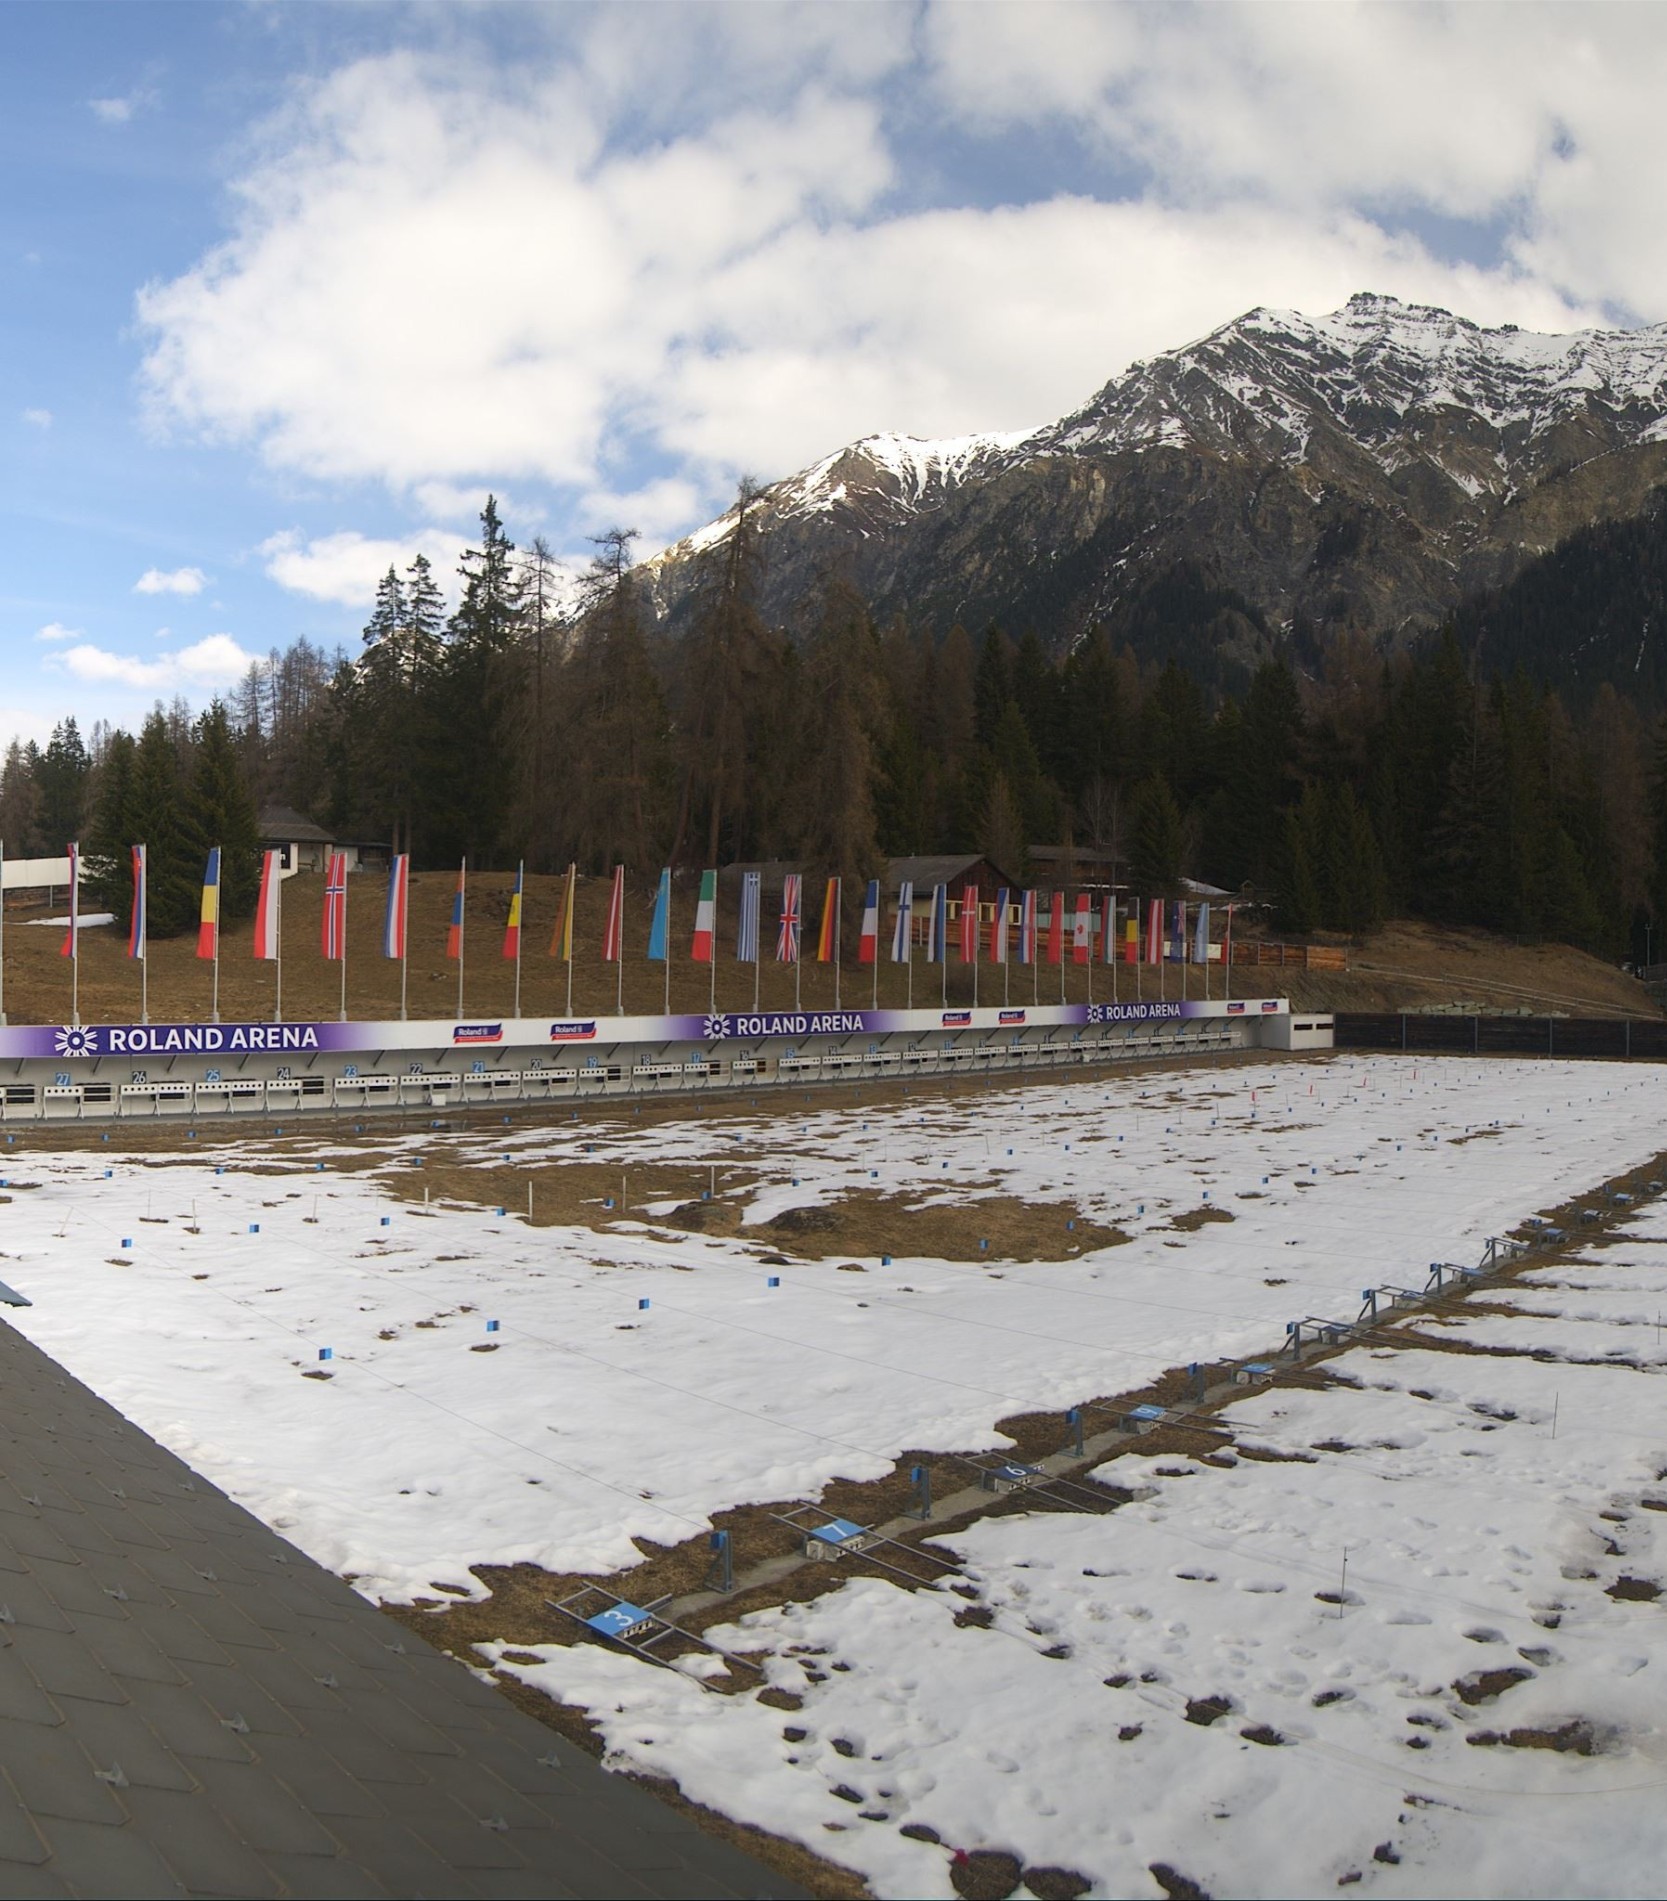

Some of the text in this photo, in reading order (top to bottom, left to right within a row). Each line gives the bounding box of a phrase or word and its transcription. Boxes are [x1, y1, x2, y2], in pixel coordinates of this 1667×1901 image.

[1106, 1004, 1181, 1020] ROLAND ARENA
[555, 1024, 576, 1034] Roland
[737, 1015, 864, 1035] ROLAND ARENA
[458, 1027, 482, 1036] Roland
[109, 1026, 319, 1051] ROLAND ARENA
[411, 1064, 423, 1074] 22
[473, 1062, 484, 1073] 21
[532, 1059, 542, 1070] 20
[207, 1070, 220, 1082] 25
[278, 1068, 291, 1080] 24
[345, 1065, 357, 1077] 23
[56, 1073, 69, 1086] 27
[133, 1071, 146, 1084] 26
[603, 1610, 634, 1627] 3
